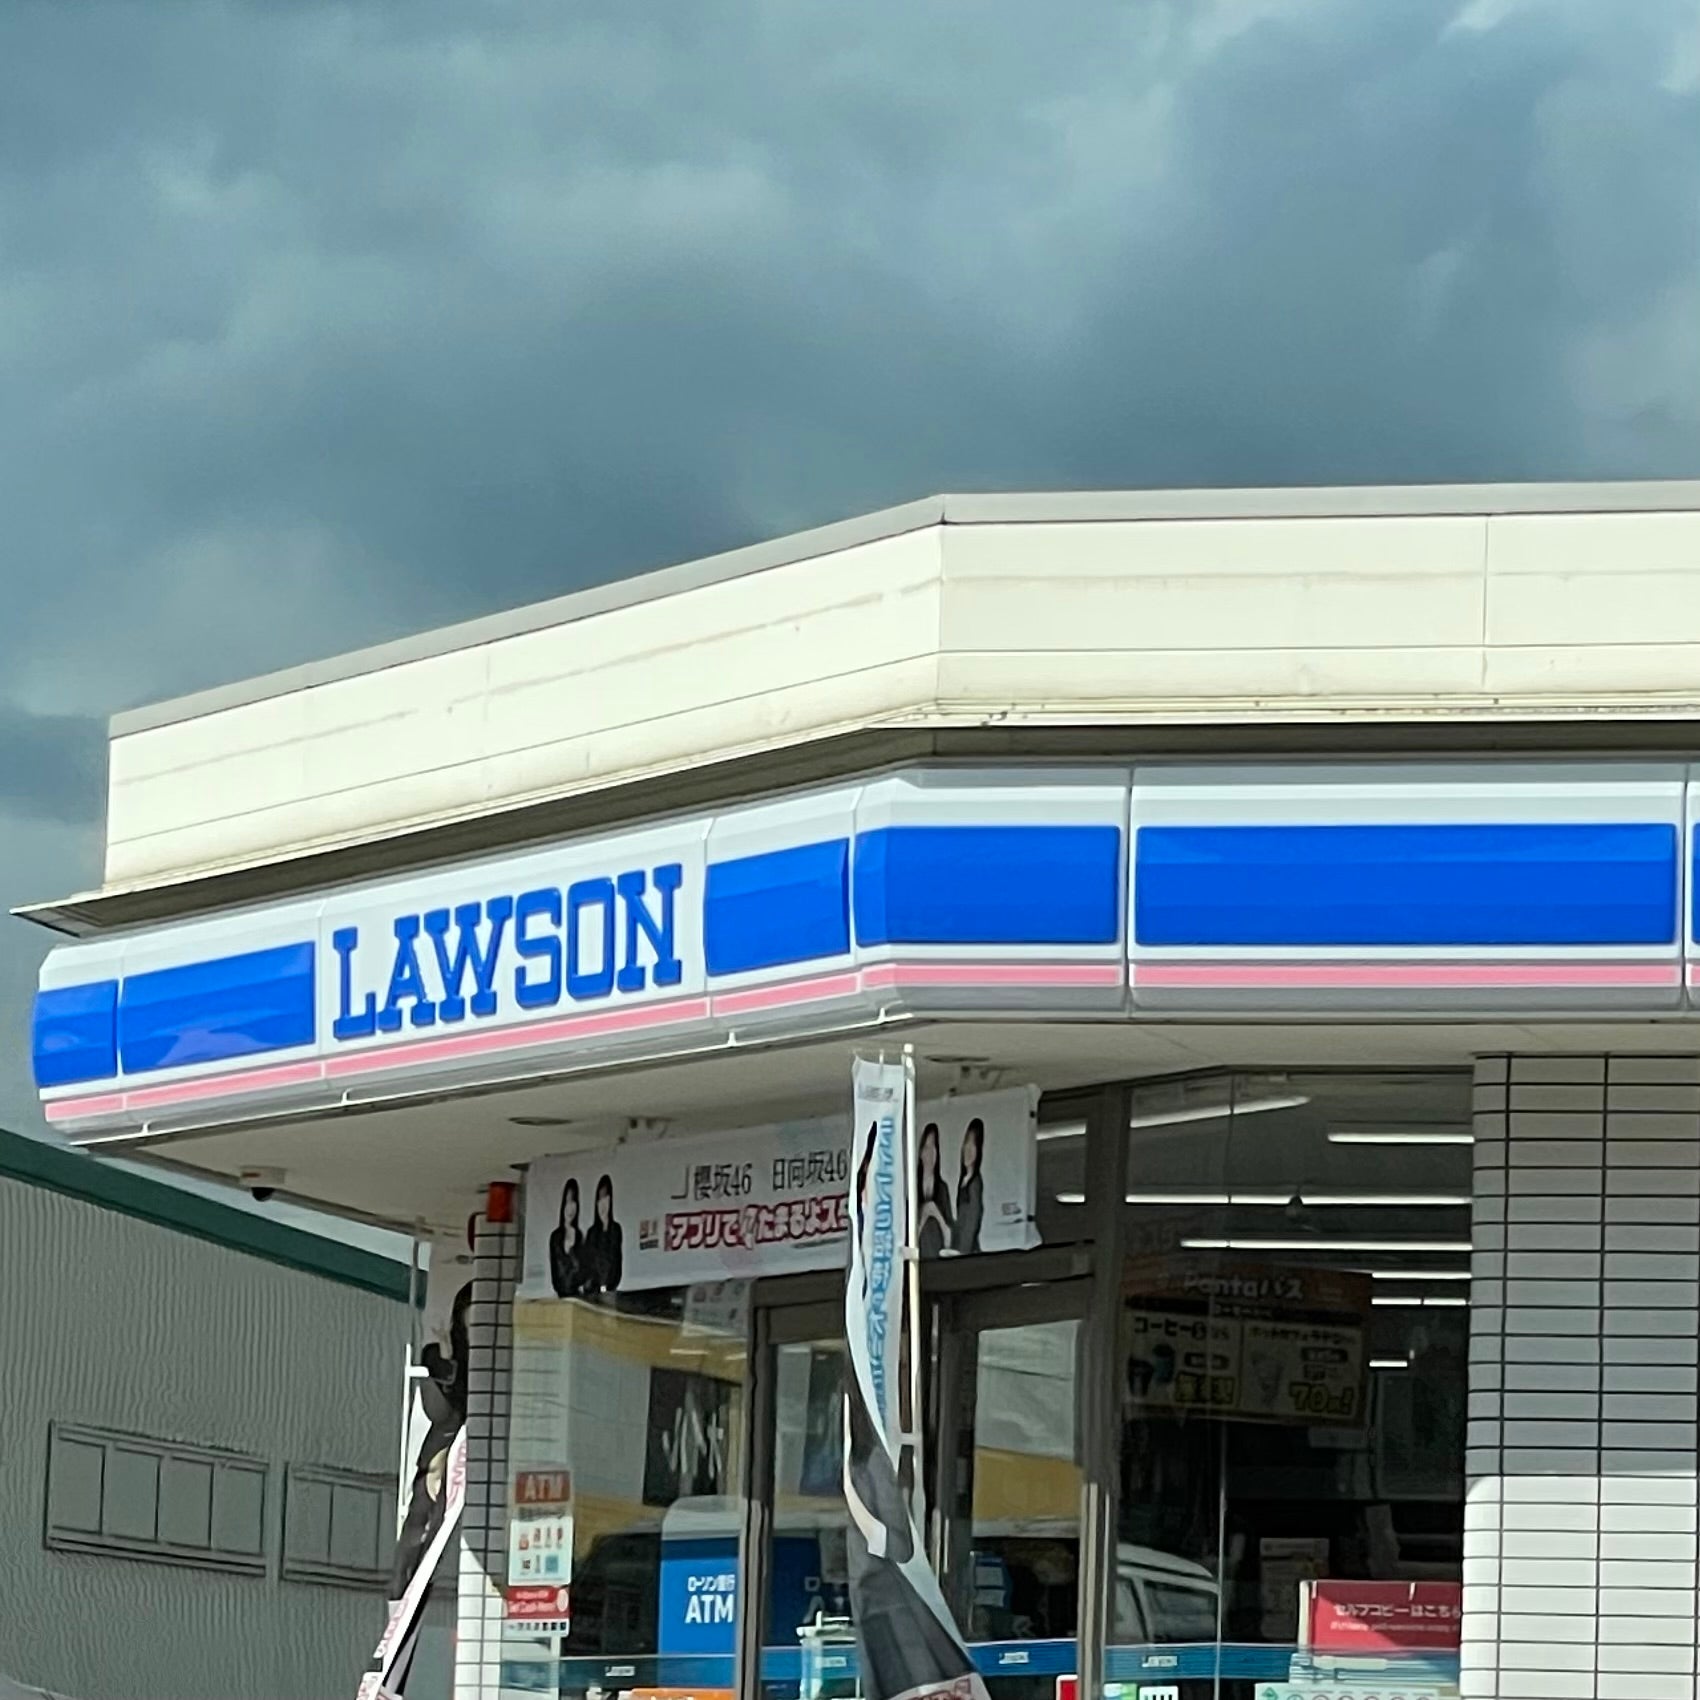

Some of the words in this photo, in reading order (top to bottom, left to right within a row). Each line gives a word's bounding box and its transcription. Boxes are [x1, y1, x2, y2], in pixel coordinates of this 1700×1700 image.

[333, 863, 682, 1042] LAWSON
[774, 1149, 849, 1191] 日向坂46
[524, 1474, 564, 1500] ATM
[688, 1574, 736, 1592] ローソン銀行
[685, 1594, 734, 1624] ATM
